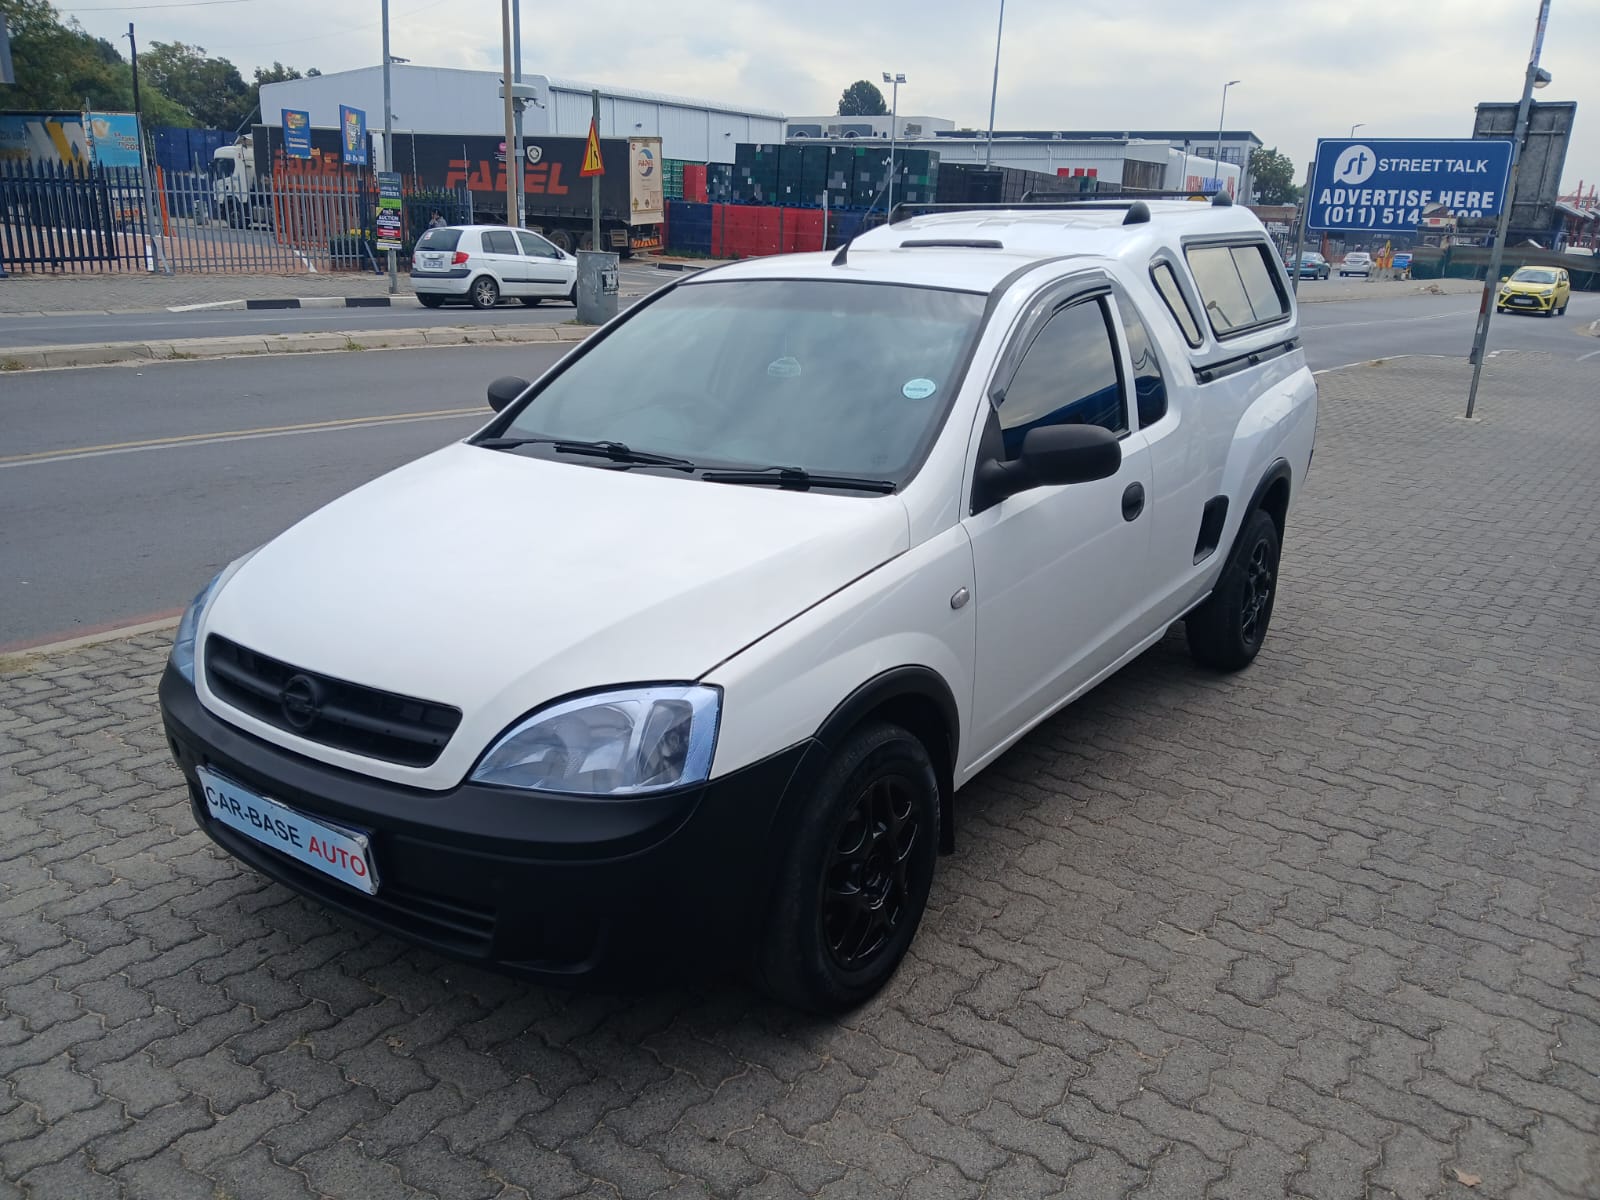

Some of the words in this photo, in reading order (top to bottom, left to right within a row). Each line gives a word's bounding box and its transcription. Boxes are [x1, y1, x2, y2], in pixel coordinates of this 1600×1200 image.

[1379, 158, 1442, 173] STREET
[1445, 159, 1488, 173] TALK
[1319, 188, 1432, 207] ADVERTISE
[1439, 190, 1495, 209] HERE
[1324, 206, 1376, 227] (011)
[205, 786, 303, 848] CAR-BASE
[308, 836, 367, 877] AUTO
